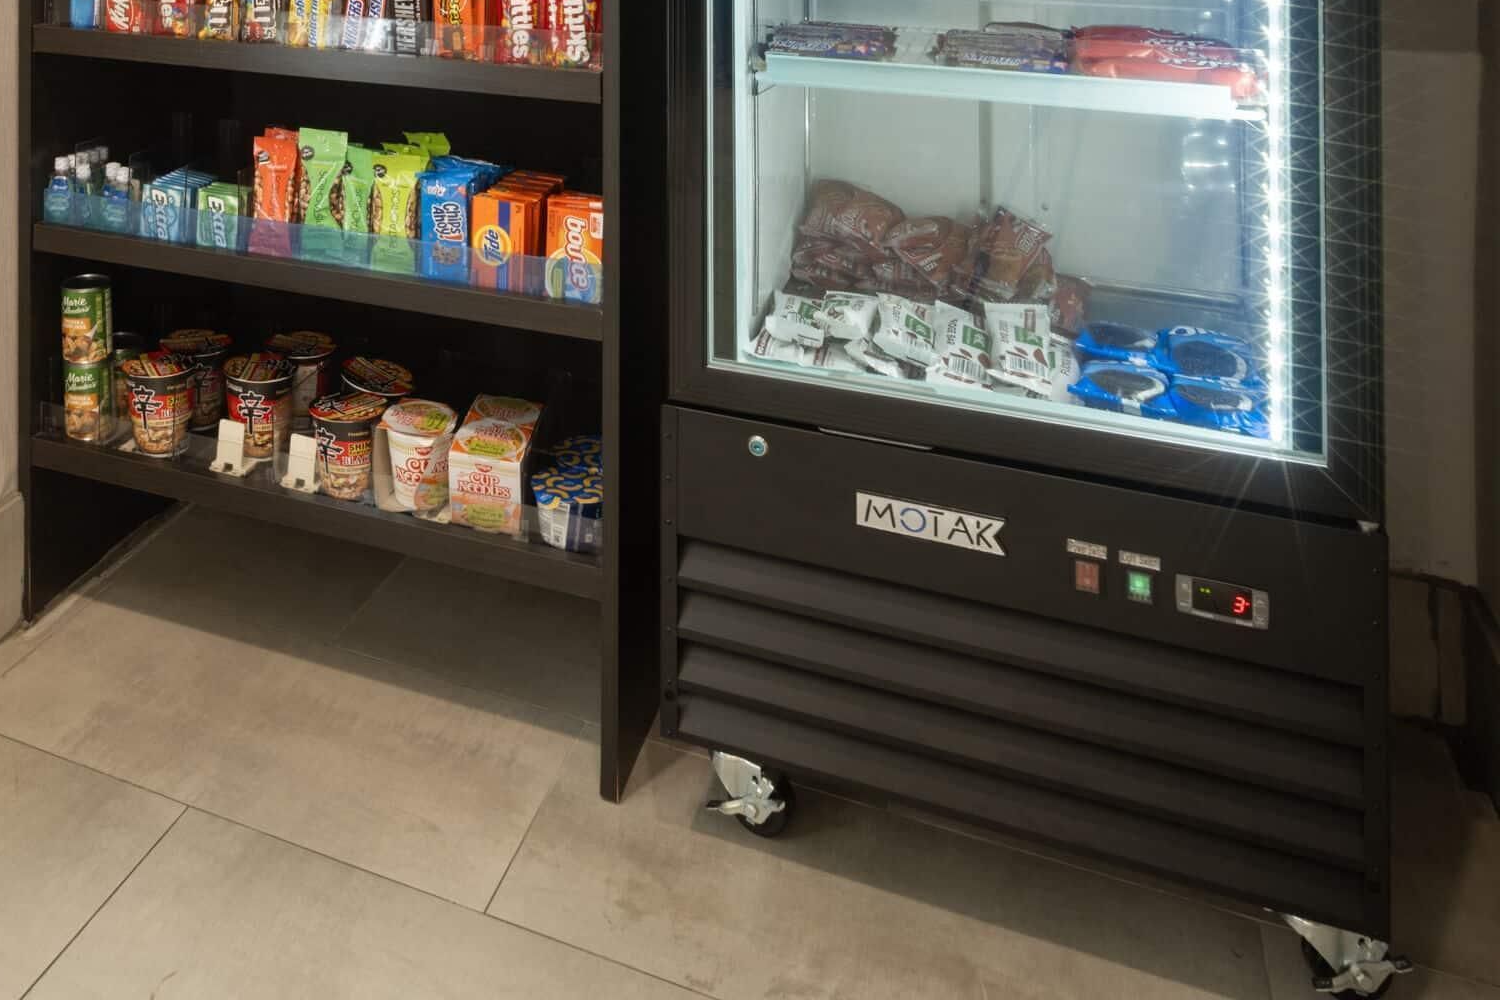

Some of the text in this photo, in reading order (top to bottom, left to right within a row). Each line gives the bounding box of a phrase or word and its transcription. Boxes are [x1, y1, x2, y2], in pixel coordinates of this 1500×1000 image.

[151, 188, 169, 241] Extra
[207, 195, 227, 249] Extra
[442, 201, 462, 236] Chips
[483, 228, 500, 262] Tide
[62, 295, 88, 307] Marie
[67, 372, 94, 383] Marie
[132, 385, 163, 432] 辛
[237, 390, 272, 436] 辛
[405, 457, 430, 473] CU
[468, 471, 501, 488] CUP
[457, 480, 512, 500] NOODLES
[863, 498, 994, 550] MOTAK
